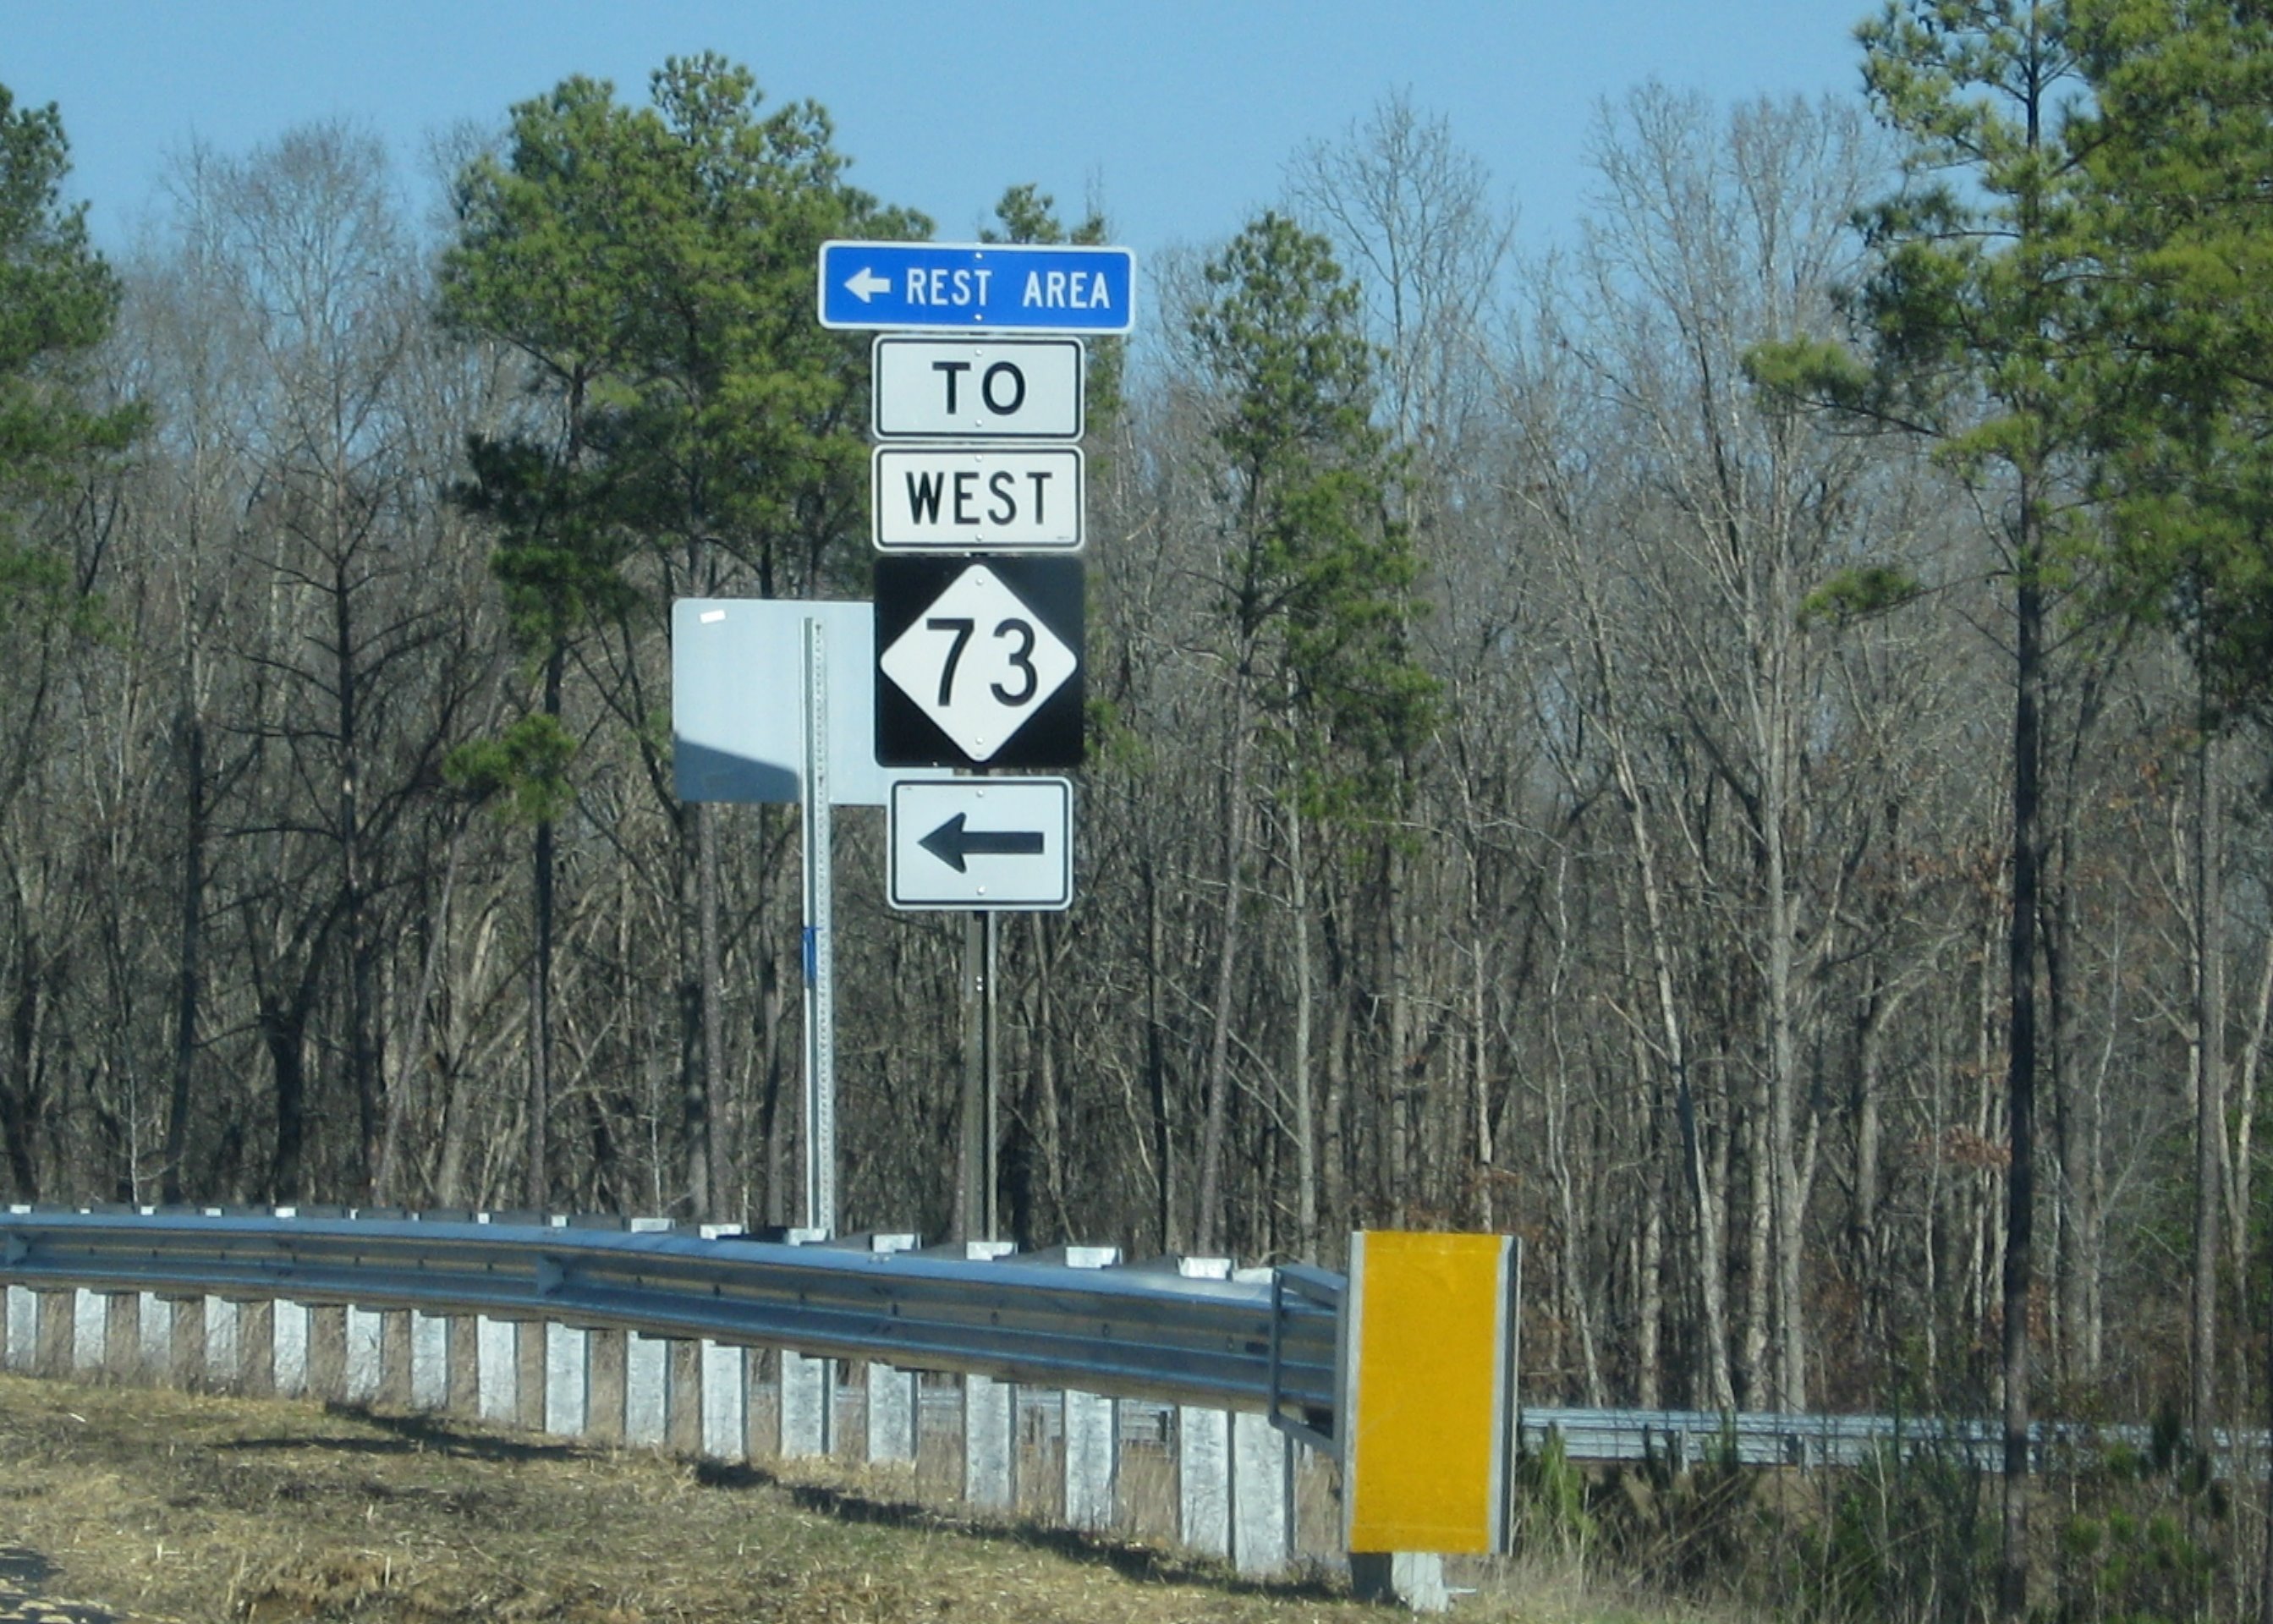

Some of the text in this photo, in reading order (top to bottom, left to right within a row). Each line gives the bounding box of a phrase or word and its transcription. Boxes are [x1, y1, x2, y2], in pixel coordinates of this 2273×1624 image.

[907, 267, 1111, 309] REST AREA
[932, 361, 1025, 415] TO
[906, 471, 1052, 525] WEST
[926, 617, 1038, 707] 73
